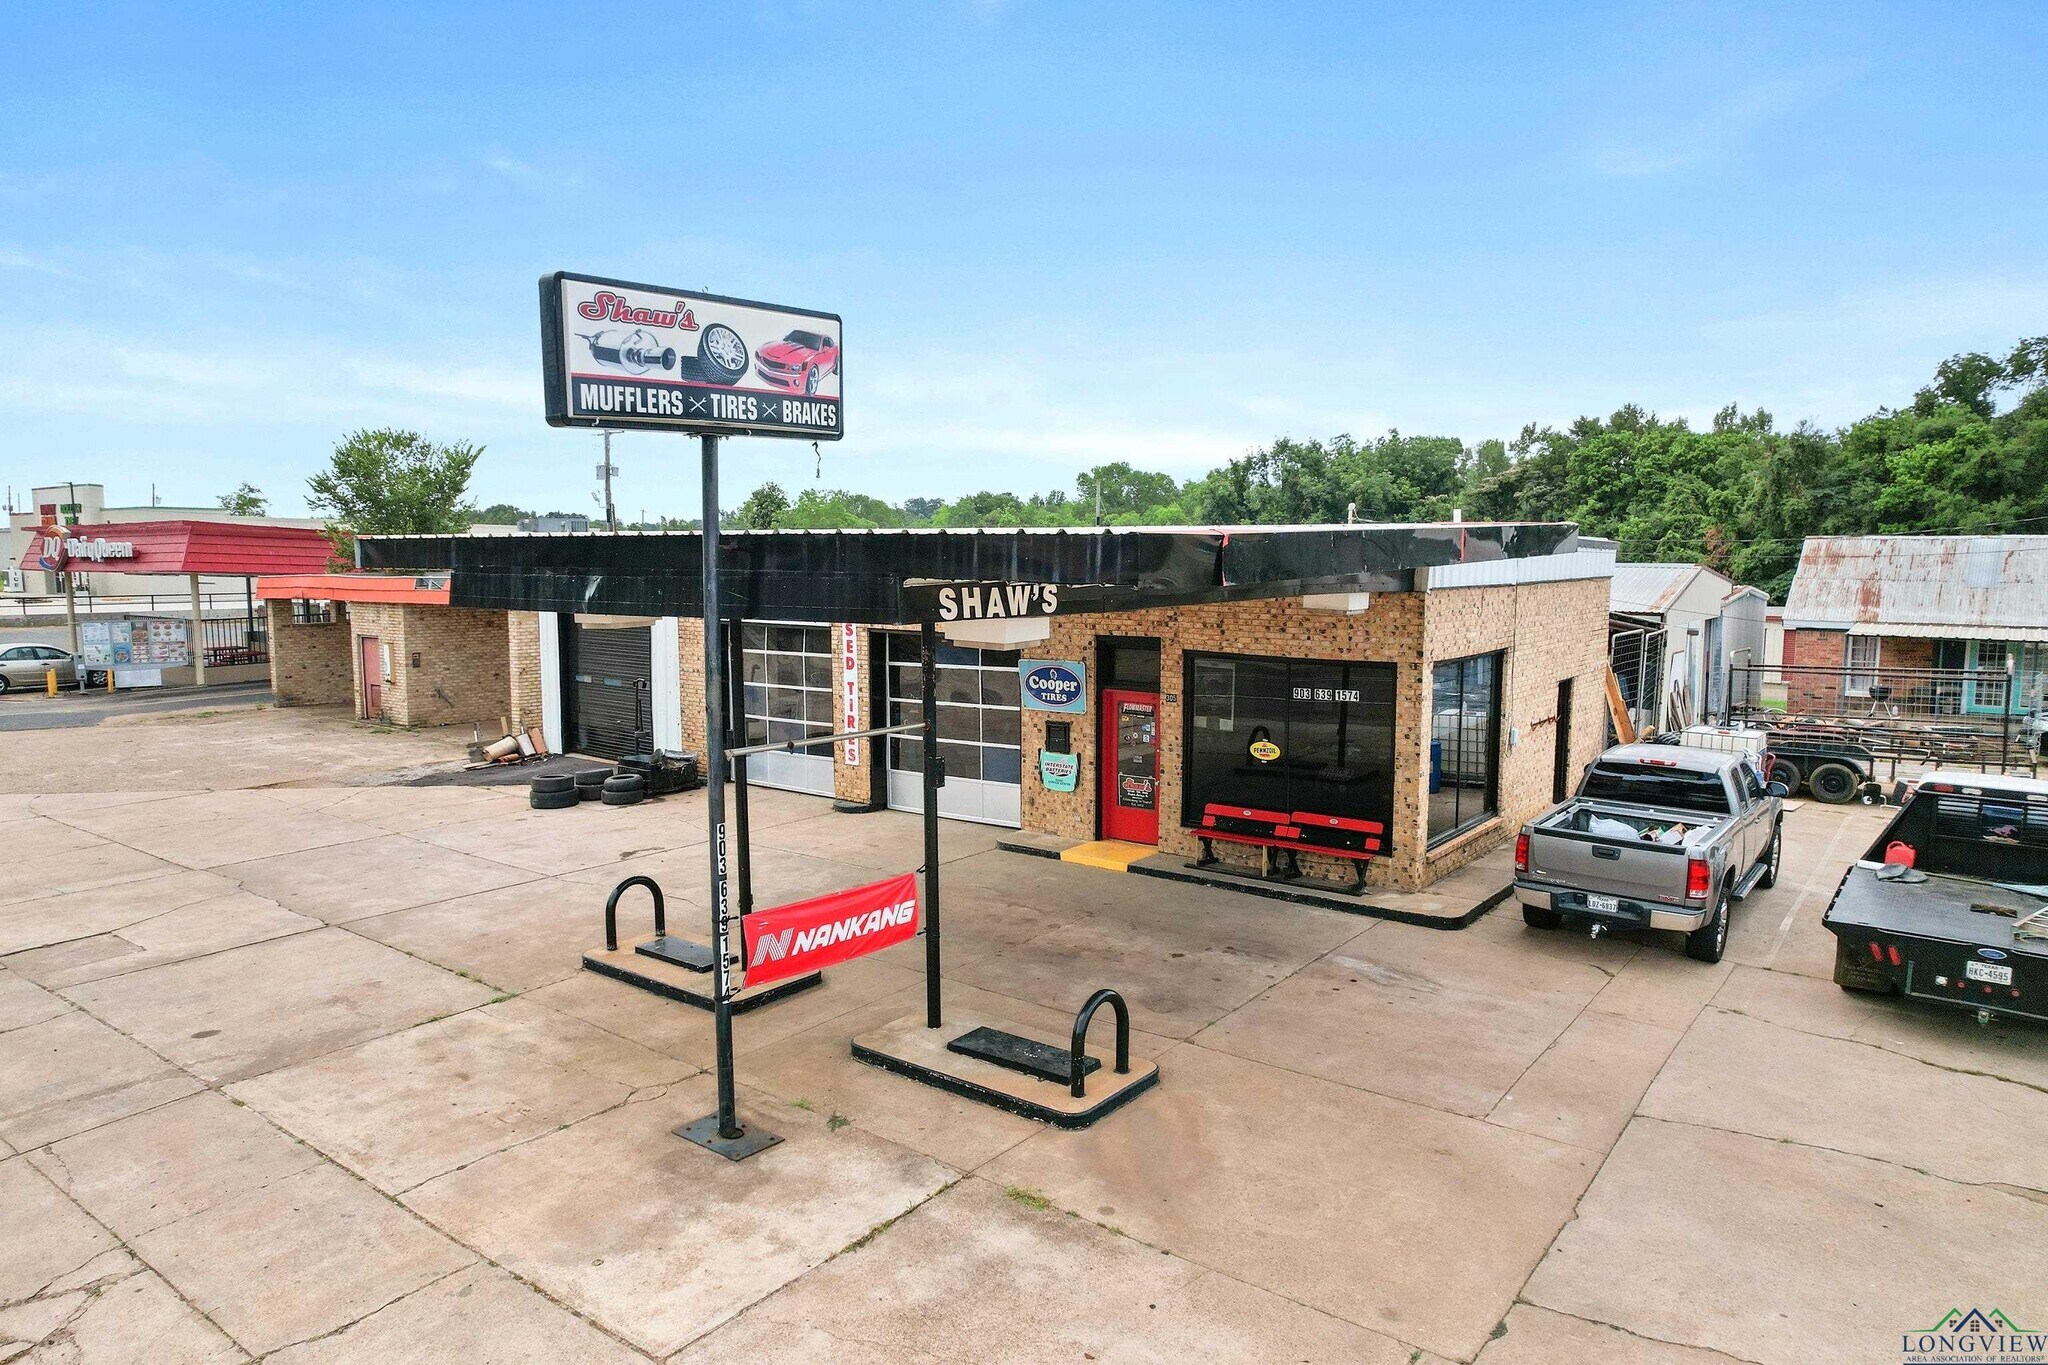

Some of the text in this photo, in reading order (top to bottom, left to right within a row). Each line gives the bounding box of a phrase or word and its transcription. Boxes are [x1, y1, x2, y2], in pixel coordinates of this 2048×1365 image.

[578, 291, 700, 332] Shaw's
[580, 383, 837, 427] MUFFLERS TIRES BRAKES
[43, 536, 61, 562] DQ
[938, 584, 1058, 620] SHAW'S
[845, 623, 855, 670] SED
[1028, 675, 1078, 694] Cooper
[1294, 688, 1359, 702] 903 639 1574
[1040, 692, 1068, 703] TIRES
[1166, 694, 1177, 702] 305
[1044, 762, 1074, 770] INTERSTATE
[1045, 767, 1072, 775] BATTERIES
[718, 823, 726, 874] 903
[791, 898, 916, 957] NANKANG
[1968, 967, 2009, 981] HKC-4595
